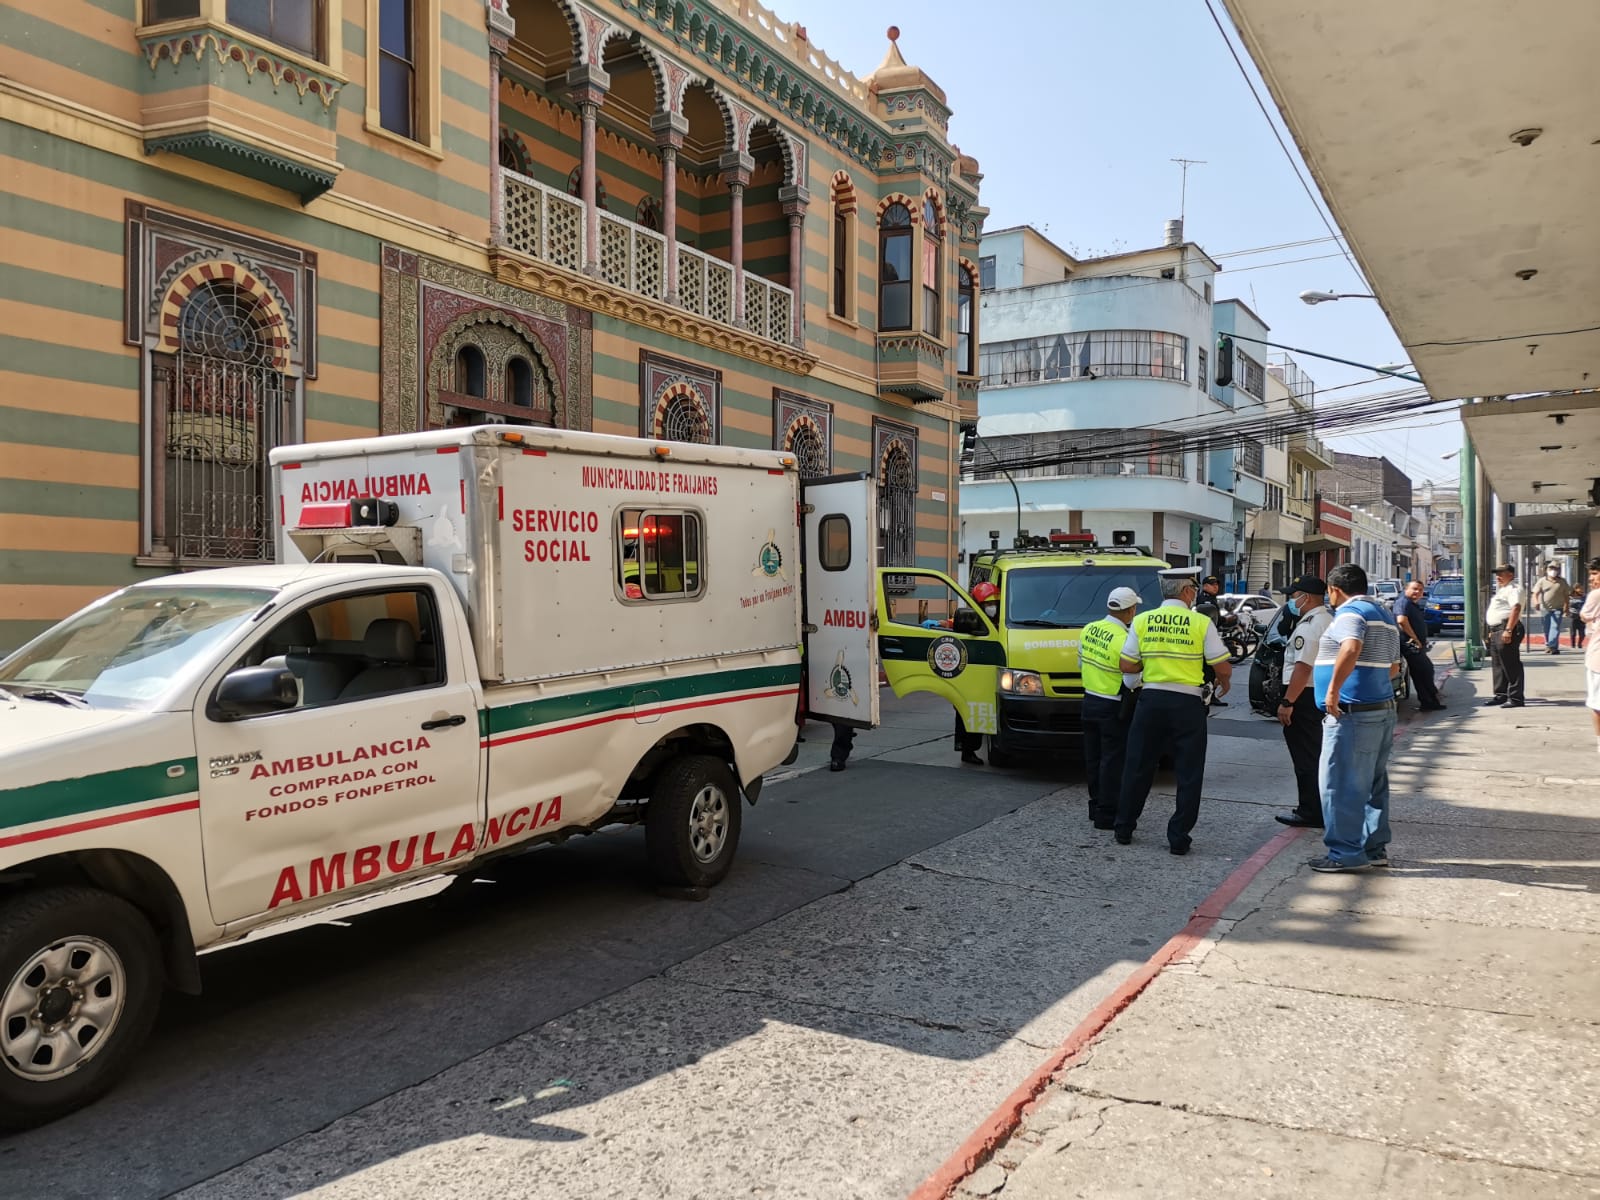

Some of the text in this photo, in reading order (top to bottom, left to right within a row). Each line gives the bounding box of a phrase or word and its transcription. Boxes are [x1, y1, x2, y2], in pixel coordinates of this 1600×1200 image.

[582, 466, 718, 495] MUNICIPALIDAD DE FRAIJANES
[513, 509, 598, 533] SERVICIO
[524, 540, 590, 562] SOCIAL
[824, 609, 866, 629] AMBU
[1147, 614, 1190, 626] POLICIA
[1147, 626, 1189, 635] MUNICIPAL
[1024, 640, 1078, 650] BOMBERO
[1087, 625, 1114, 643] POLICIA
[249, 736, 431, 780] AMBULANCIA
[269, 760, 418, 797] COMPRADA CON
[245, 775, 437, 821] FONDOS FONPETROL
[267, 796, 562, 909] AMBULANCIA
